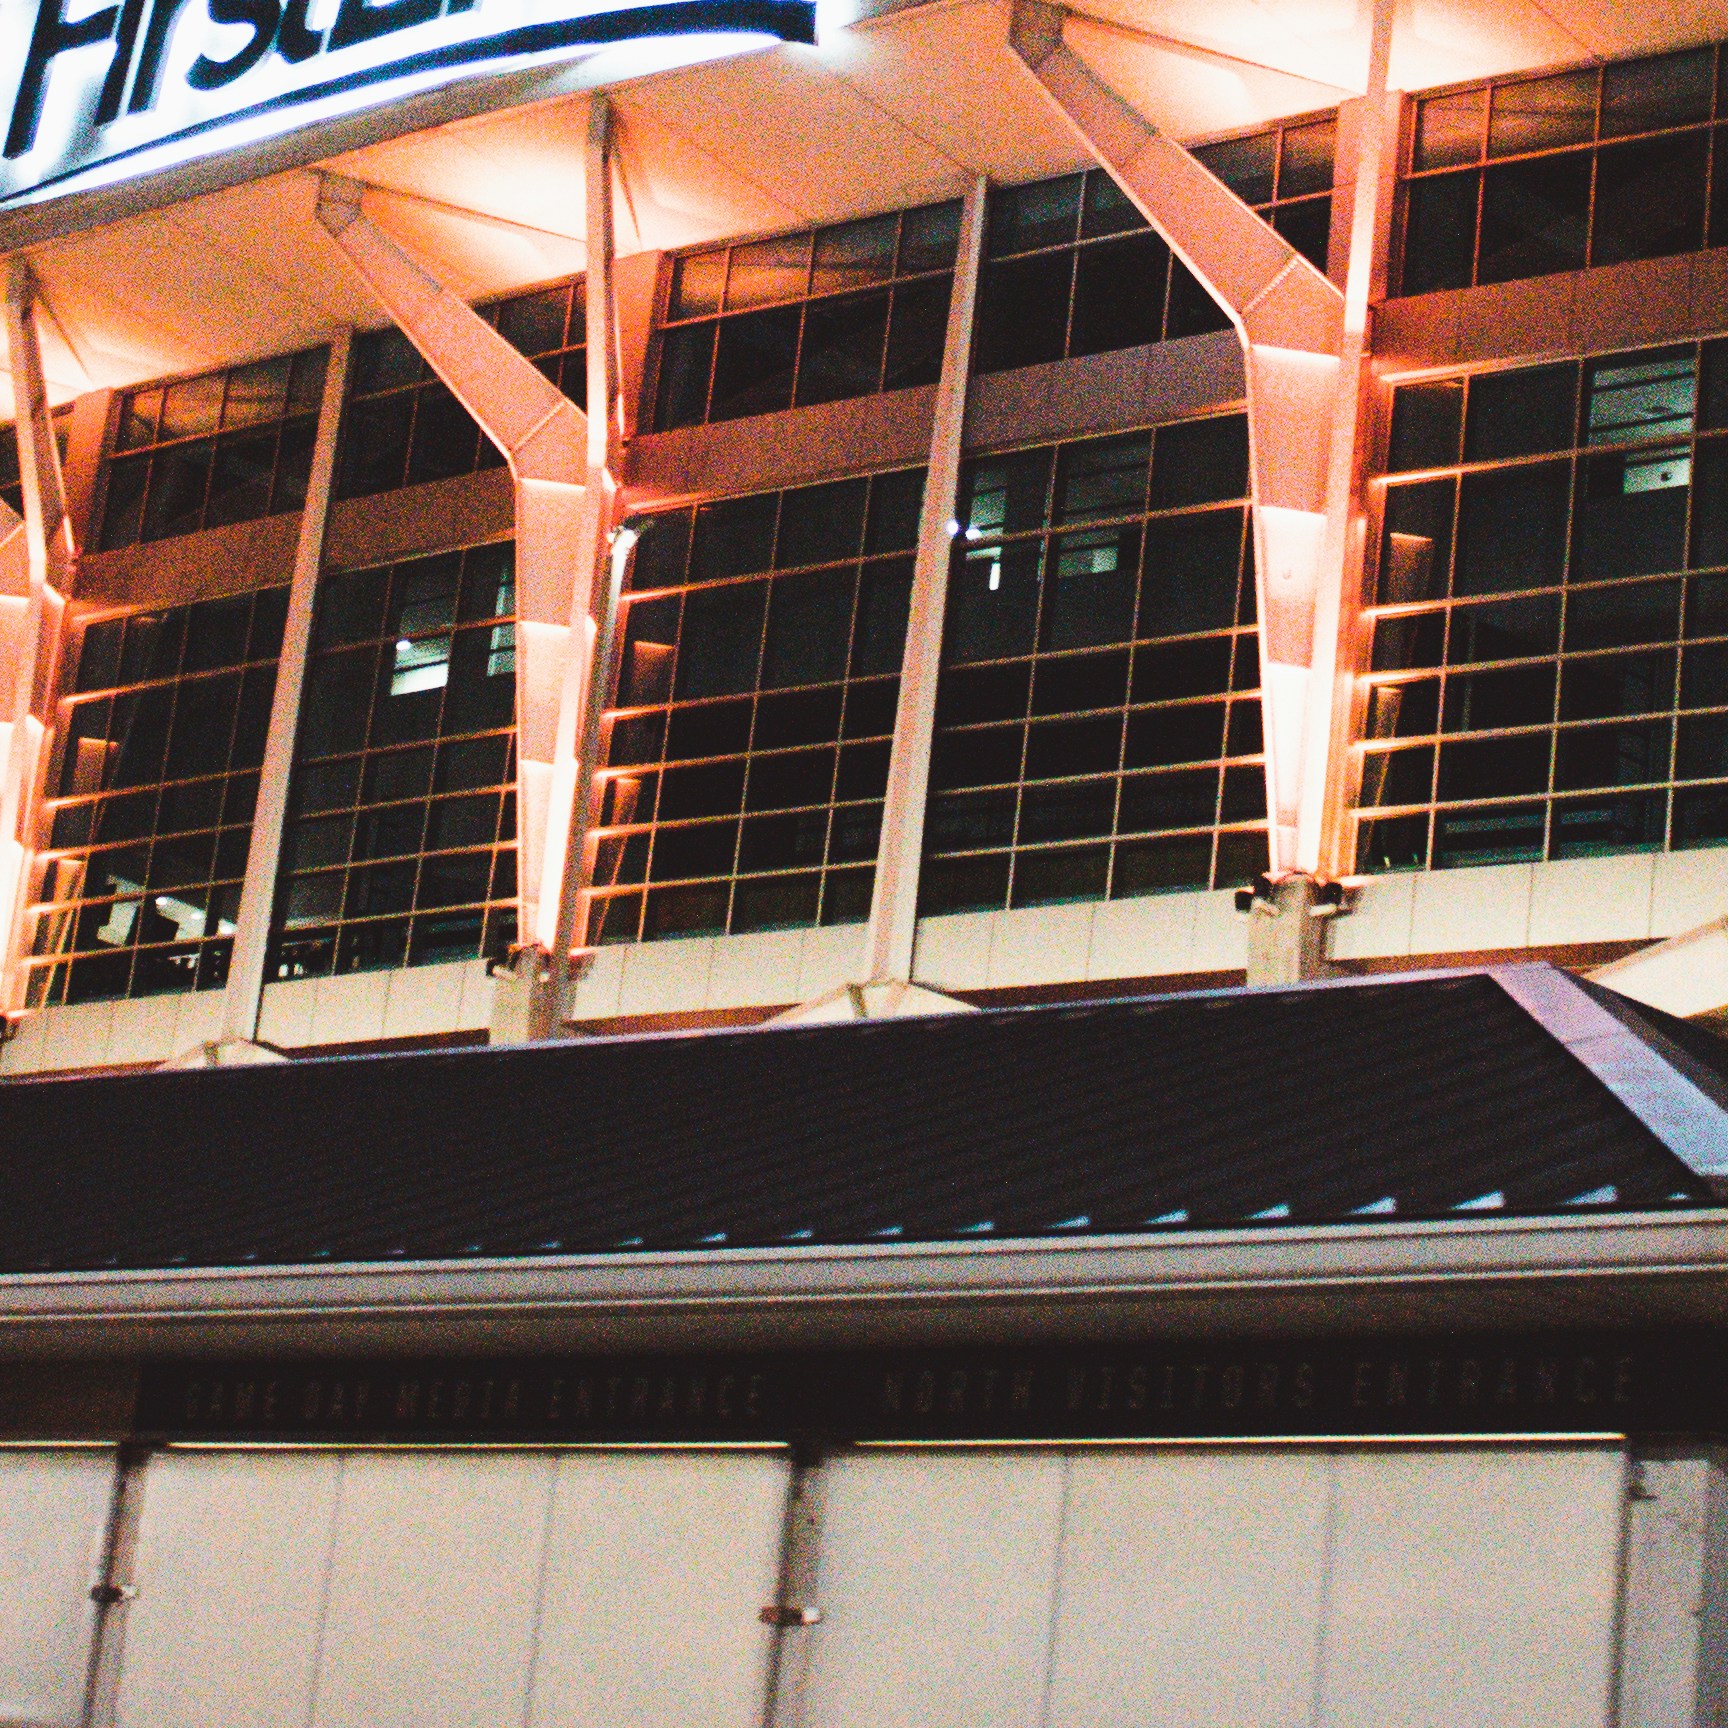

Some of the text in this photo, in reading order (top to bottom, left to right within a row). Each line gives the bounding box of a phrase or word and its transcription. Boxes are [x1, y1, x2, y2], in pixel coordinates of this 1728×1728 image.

[183, 1374, 765, 1420] GAME DAY MEDIA ENTRANCE
[881, 1355, 1635, 1412] NORTH VISITORS ENTRANCE
